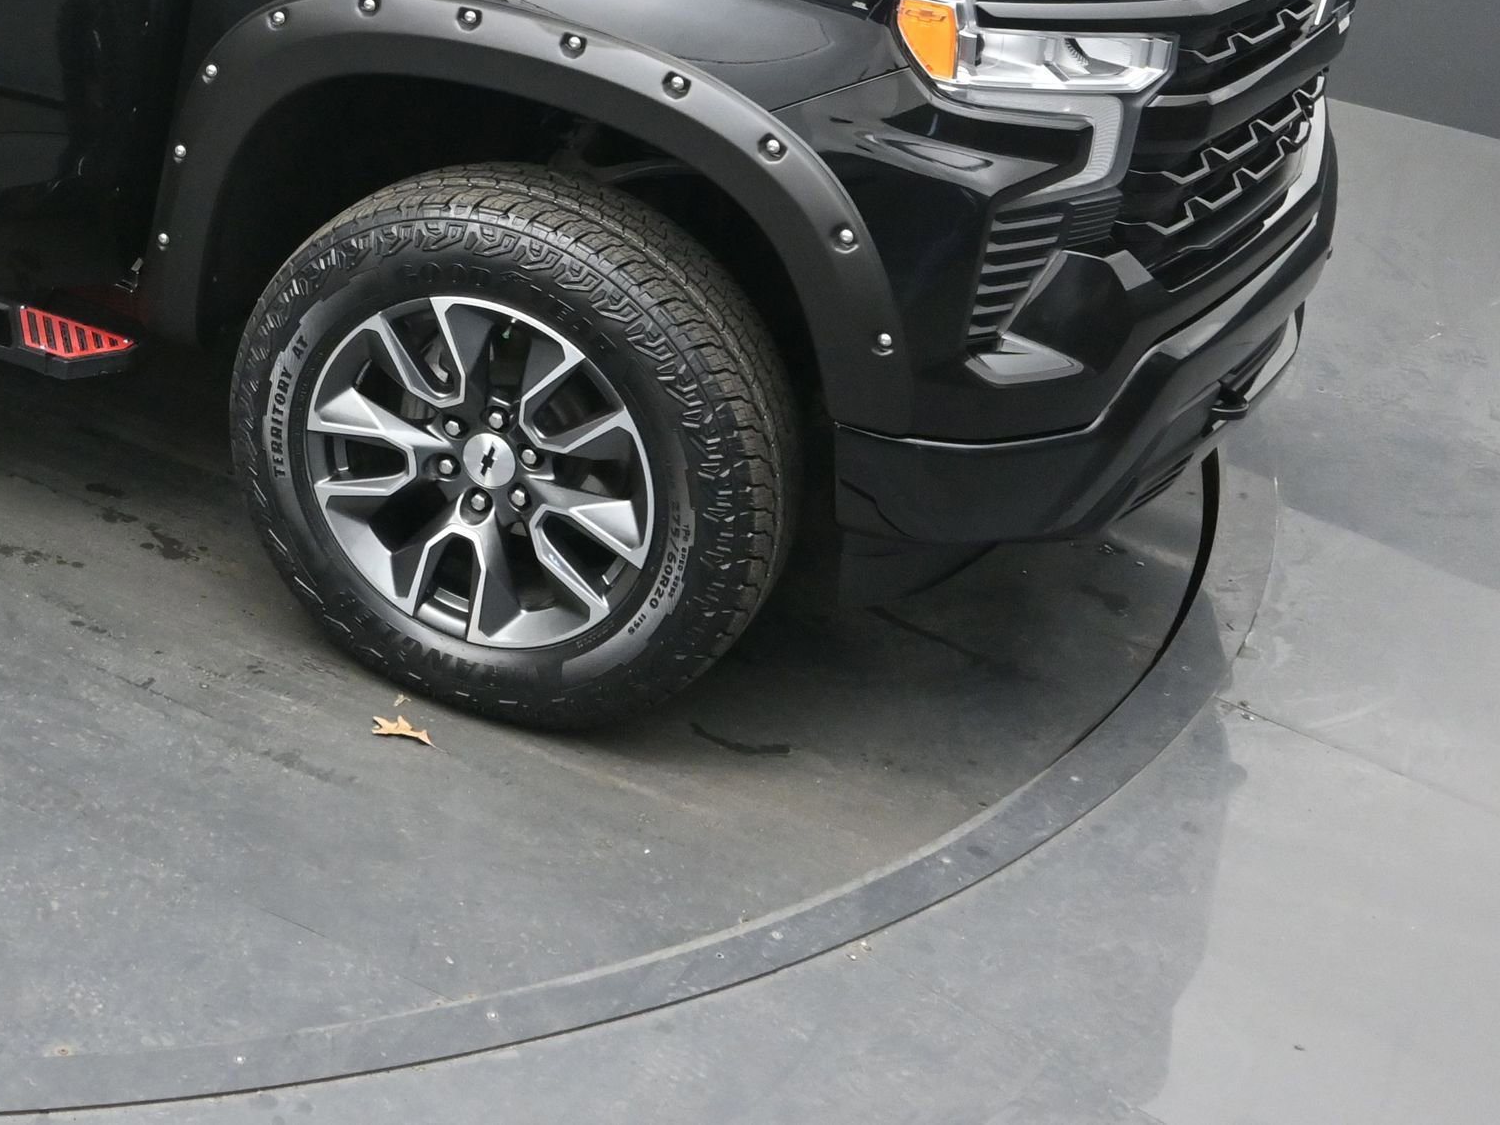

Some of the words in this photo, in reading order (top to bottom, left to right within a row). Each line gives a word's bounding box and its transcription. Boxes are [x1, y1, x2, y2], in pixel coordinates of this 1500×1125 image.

[270, 366, 293, 478] TERRITORY
[291, 335, 309, 361] AT
[649, 500, 681, 610] 275/60R20
